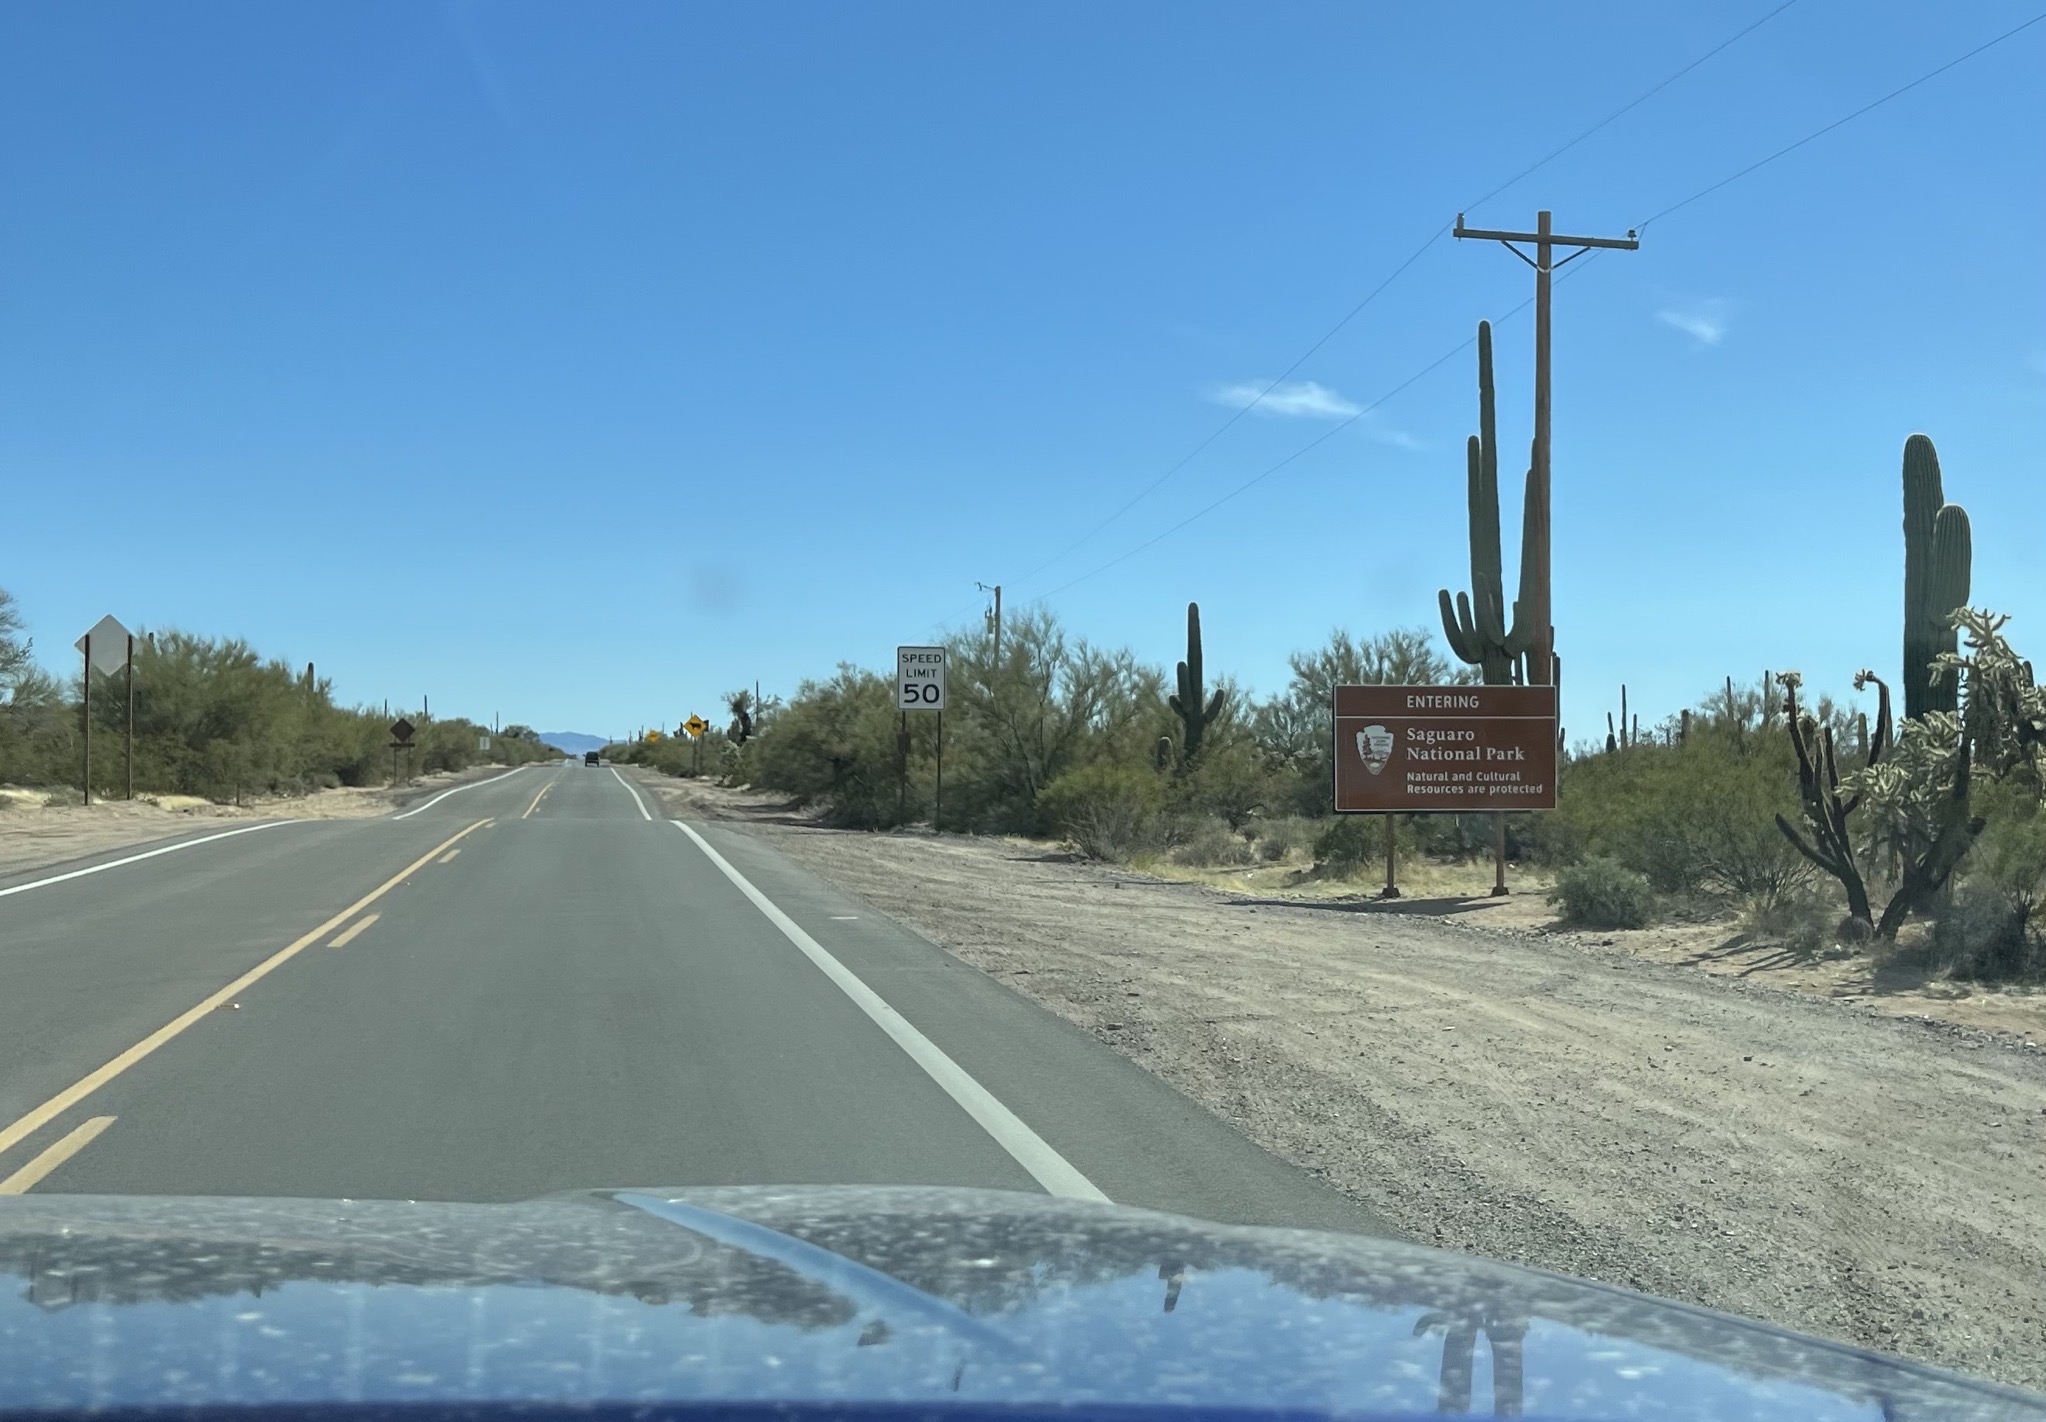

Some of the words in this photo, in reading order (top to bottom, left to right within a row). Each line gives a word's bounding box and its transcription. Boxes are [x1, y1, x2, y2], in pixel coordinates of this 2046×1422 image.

[902, 654, 942, 663] SPEED
[906, 669, 937, 678] LIMIT
[904, 684, 939, 703] 50
[1407, 695, 1479, 708] ENTERING
[1407, 728, 1474, 744] Saguaro
[1407, 747, 1480, 760] National
[1486, 747, 1525, 760] Park
[1407, 771, 1448, 781] Natural
[1452, 771, 1472, 781] and
[1476, 771, 1520, 781] Cultural
[1407, 784, 1464, 794] Resources
[1468, 786, 1485, 794] are
[1489, 784, 1543, 796] protected
